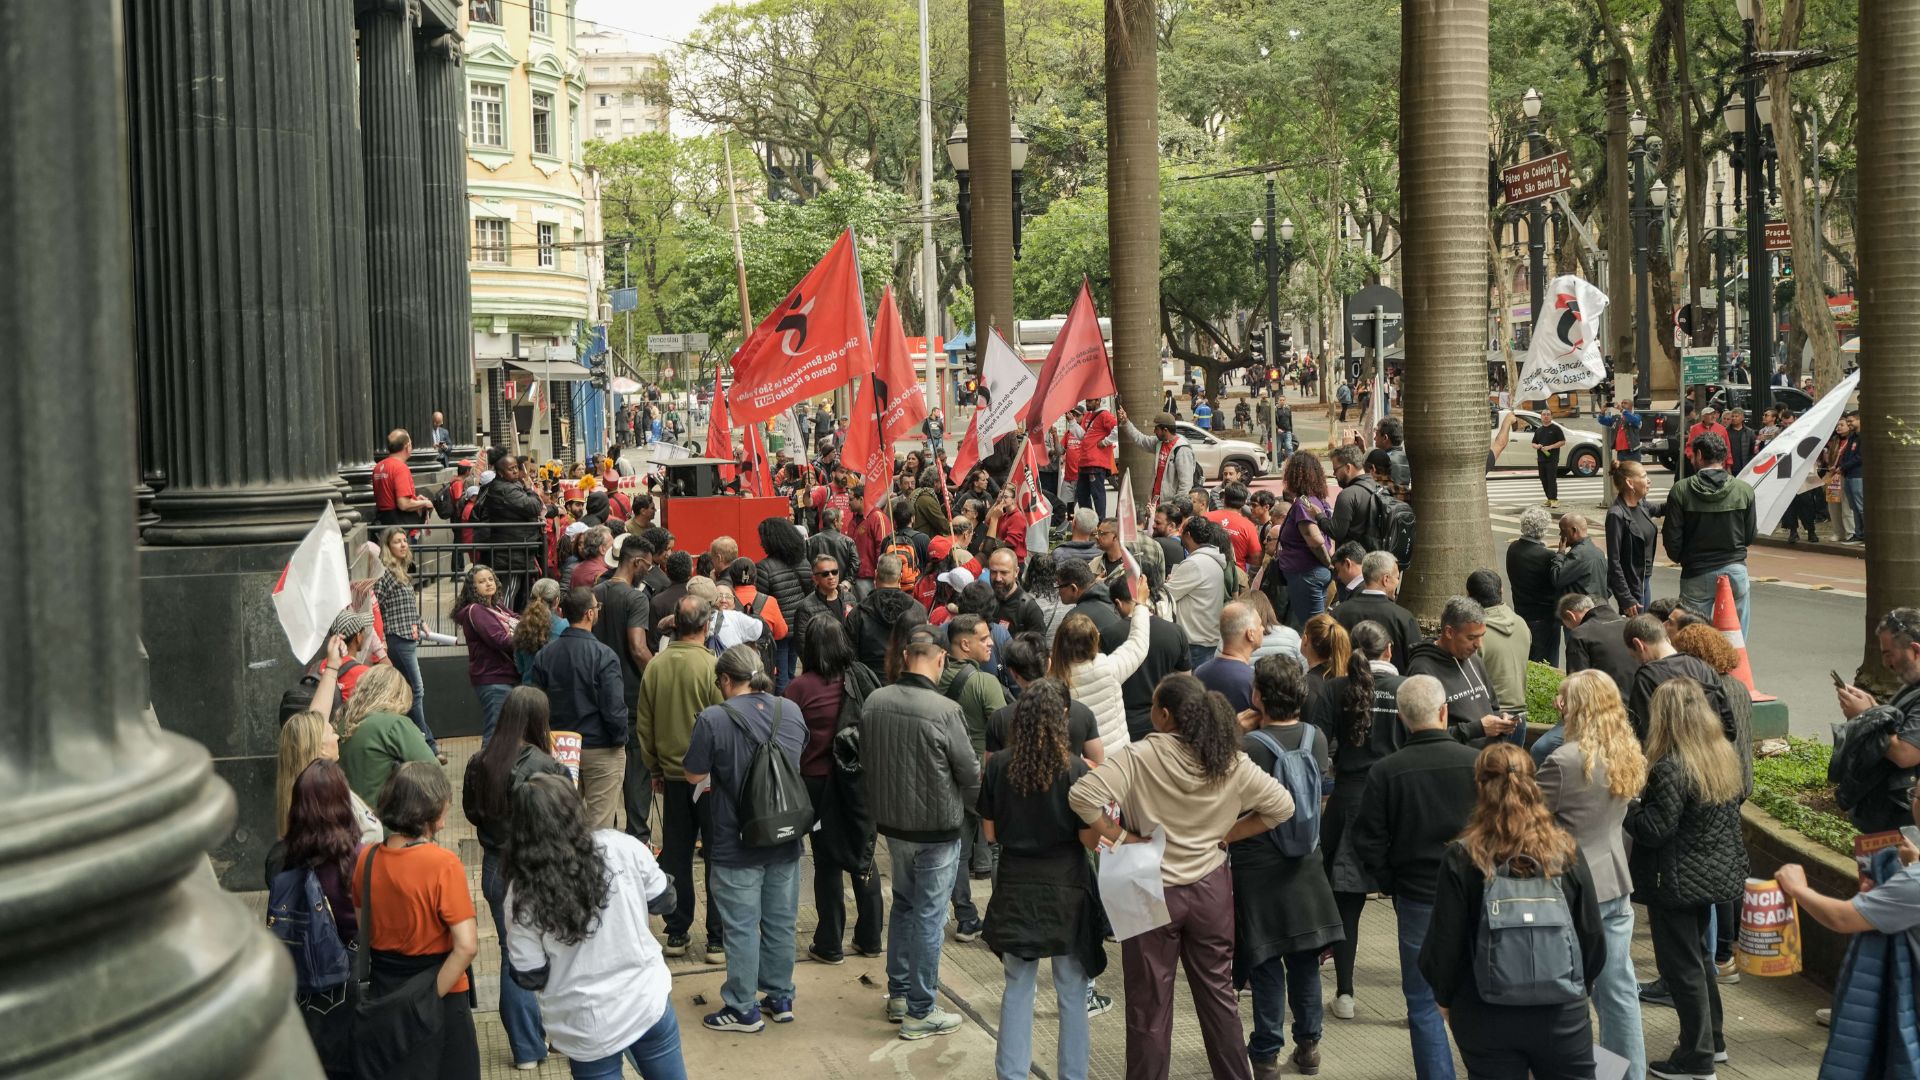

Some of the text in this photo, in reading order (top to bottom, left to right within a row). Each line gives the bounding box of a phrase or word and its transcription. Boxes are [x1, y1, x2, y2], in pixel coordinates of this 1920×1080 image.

[1522, 170, 1530, 180] do
[1531, 163, 1552, 178] Colégio
[1524, 182, 1536, 194] São
[1537, 178, 1553, 191] Bento
[1765, 229, 1785, 238] Praça
[1563, 371, 1586, 385] Osasco
